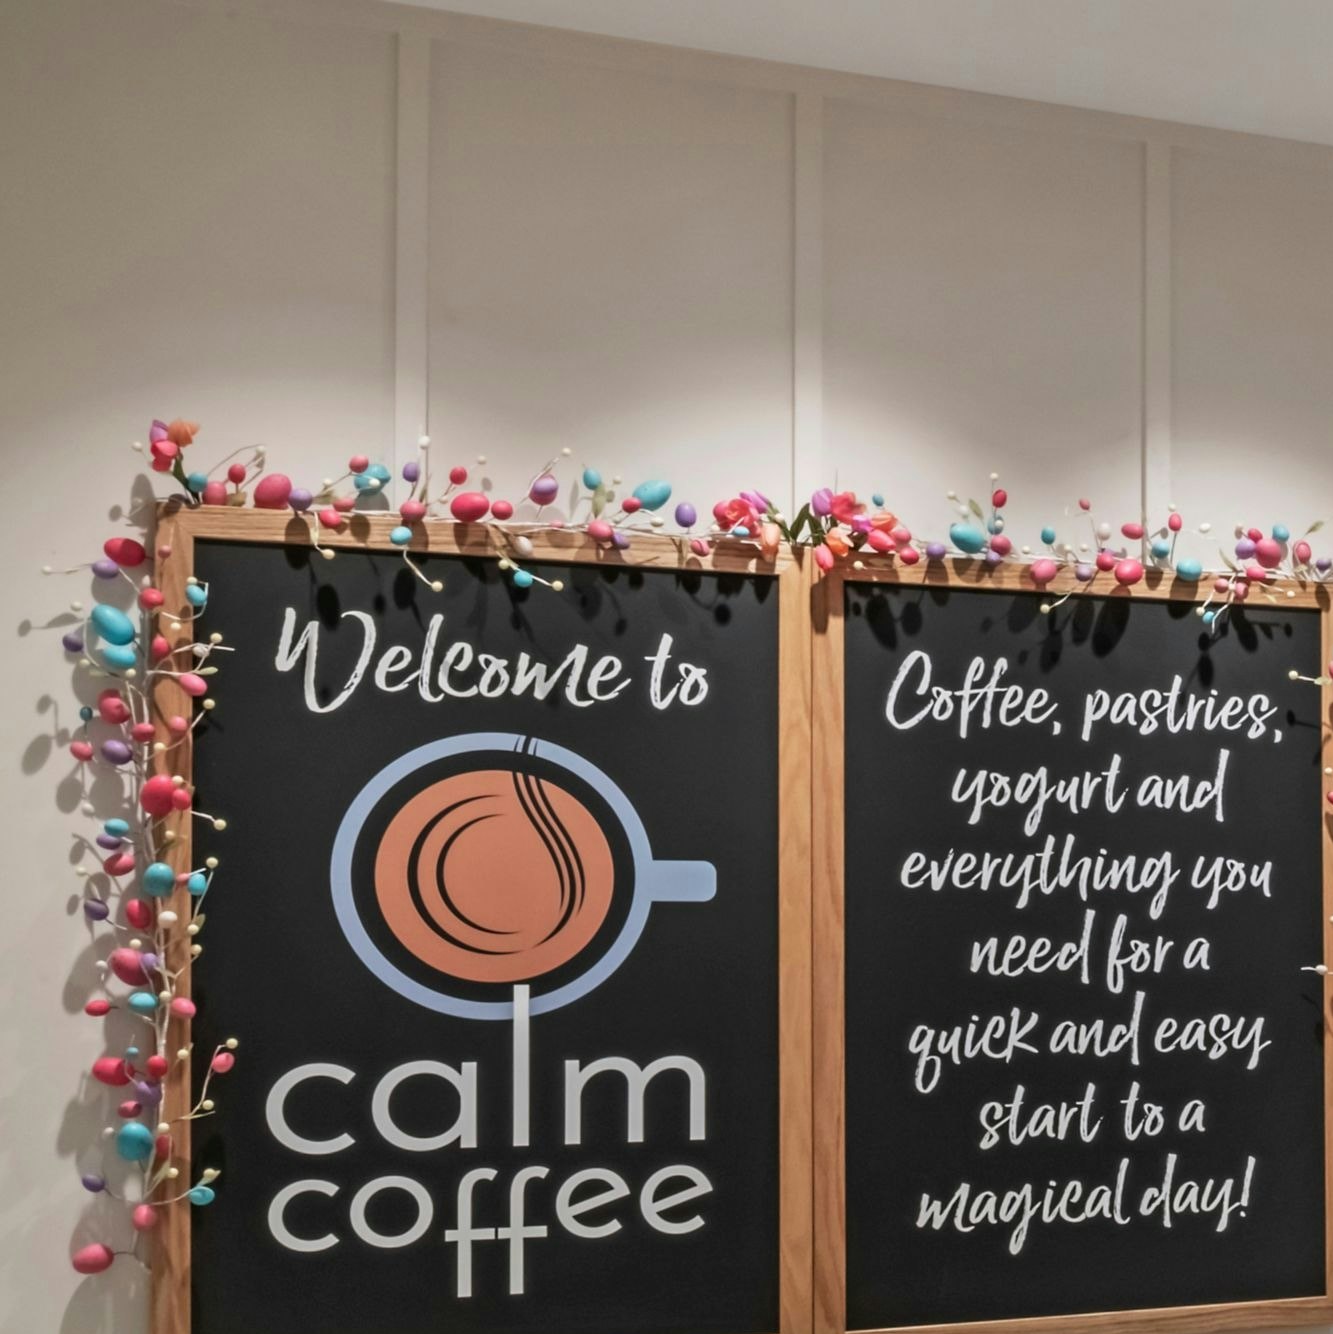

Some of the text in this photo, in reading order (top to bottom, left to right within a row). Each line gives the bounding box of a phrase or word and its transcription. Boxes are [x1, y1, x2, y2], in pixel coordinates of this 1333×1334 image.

[275, 607, 708, 713] Welcome to
[887, 651, 1282, 743] Coffee, pastries,
[952, 749, 1230, 836] yogurt and
[902, 835, 1273, 920] everything you
[971, 910, 1211, 993] need for a
[266, 984, 705, 1154] calm
[910, 992, 1272, 1093] quick and easy
[980, 1082, 1206, 1149] start to a
[268, 1165, 713, 1297] coffee
[916, 1154, 1256, 1255] magical day!
